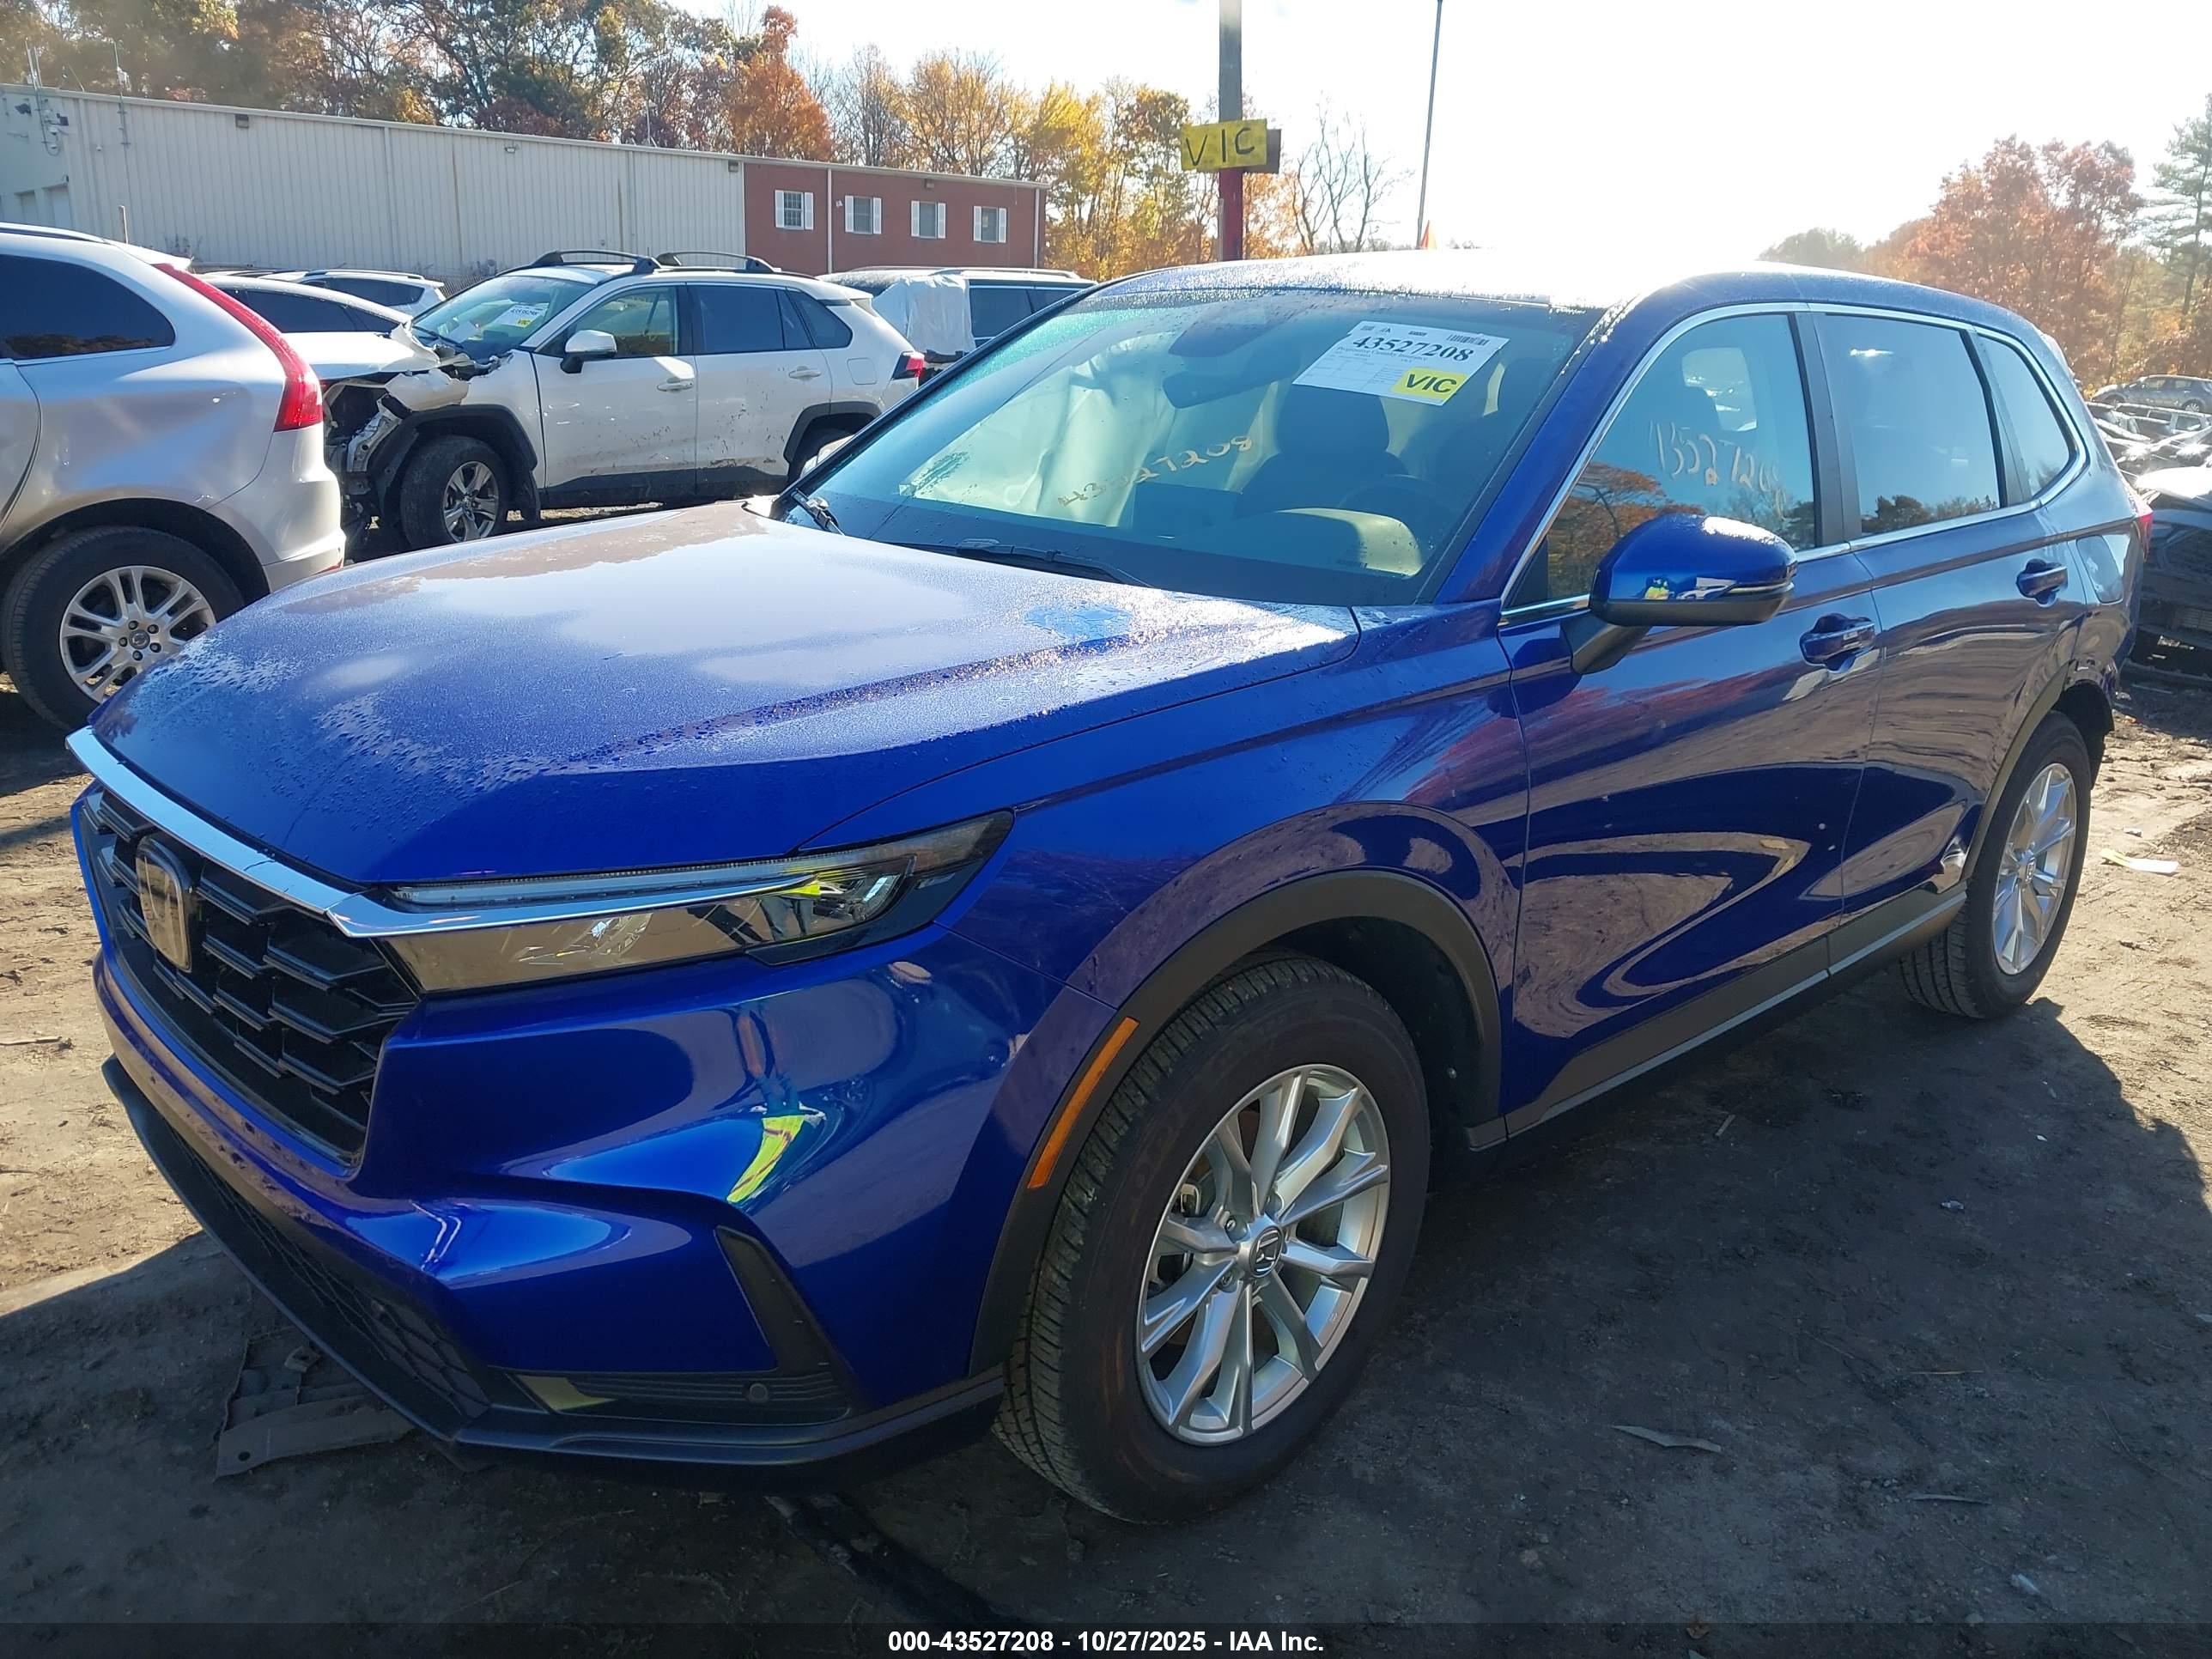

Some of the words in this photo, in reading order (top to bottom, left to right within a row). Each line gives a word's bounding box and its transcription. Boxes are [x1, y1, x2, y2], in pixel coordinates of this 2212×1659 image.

[1186, 127, 1255, 167] VIC
[1352, 336, 1474, 362] 43527208
[1406, 373, 1458, 394] VIC
[1057, 434, 1254, 507] 4327208
